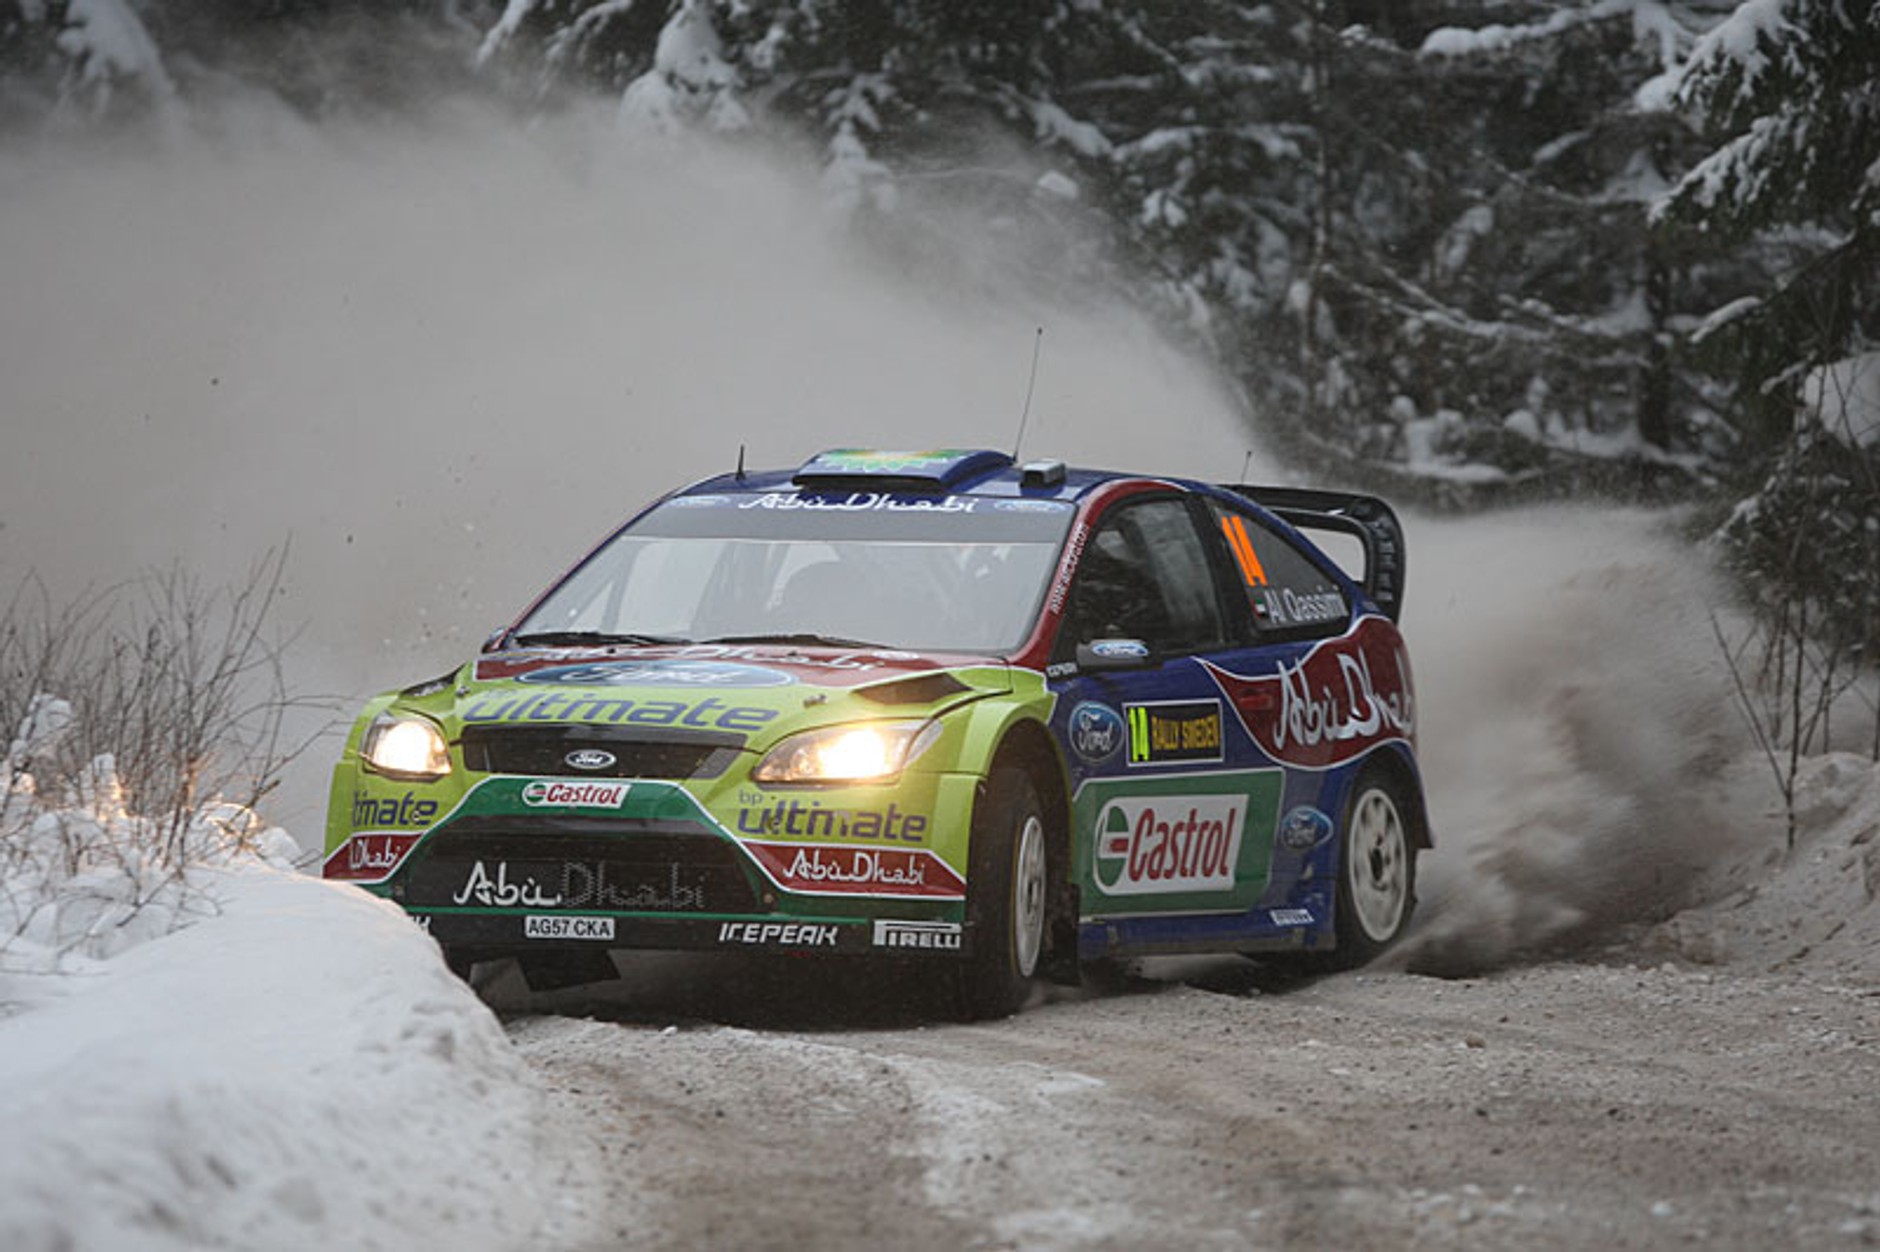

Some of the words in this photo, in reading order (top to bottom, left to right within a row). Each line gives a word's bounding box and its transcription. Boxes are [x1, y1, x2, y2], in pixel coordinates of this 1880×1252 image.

[739, 493, 844, 511] Abu
[846, 492, 979, 512] Dhabi
[462, 692, 780, 730] ultimate
[1273, 657, 1338, 749] Abu
[1078, 710, 1114, 751] Ford
[1152, 715, 1179, 750] RALLY
[547, 784, 622, 804] Castrol
[739, 788, 764, 805] bp
[738, 796, 926, 842] ultimate
[1128, 808, 1237, 882] Castrol
[453, 860, 561, 906] Abu
[562, 861, 705, 908] Dhabi
[783, 849, 847, 880] Abu
[849, 852, 925, 885] Dhabi
[528, 918, 569, 935] AG57
[574, 919, 612, 937] CKA
[719, 922, 838, 945] ICEPEAK
[873, 919, 962, 949] PIRELLI
